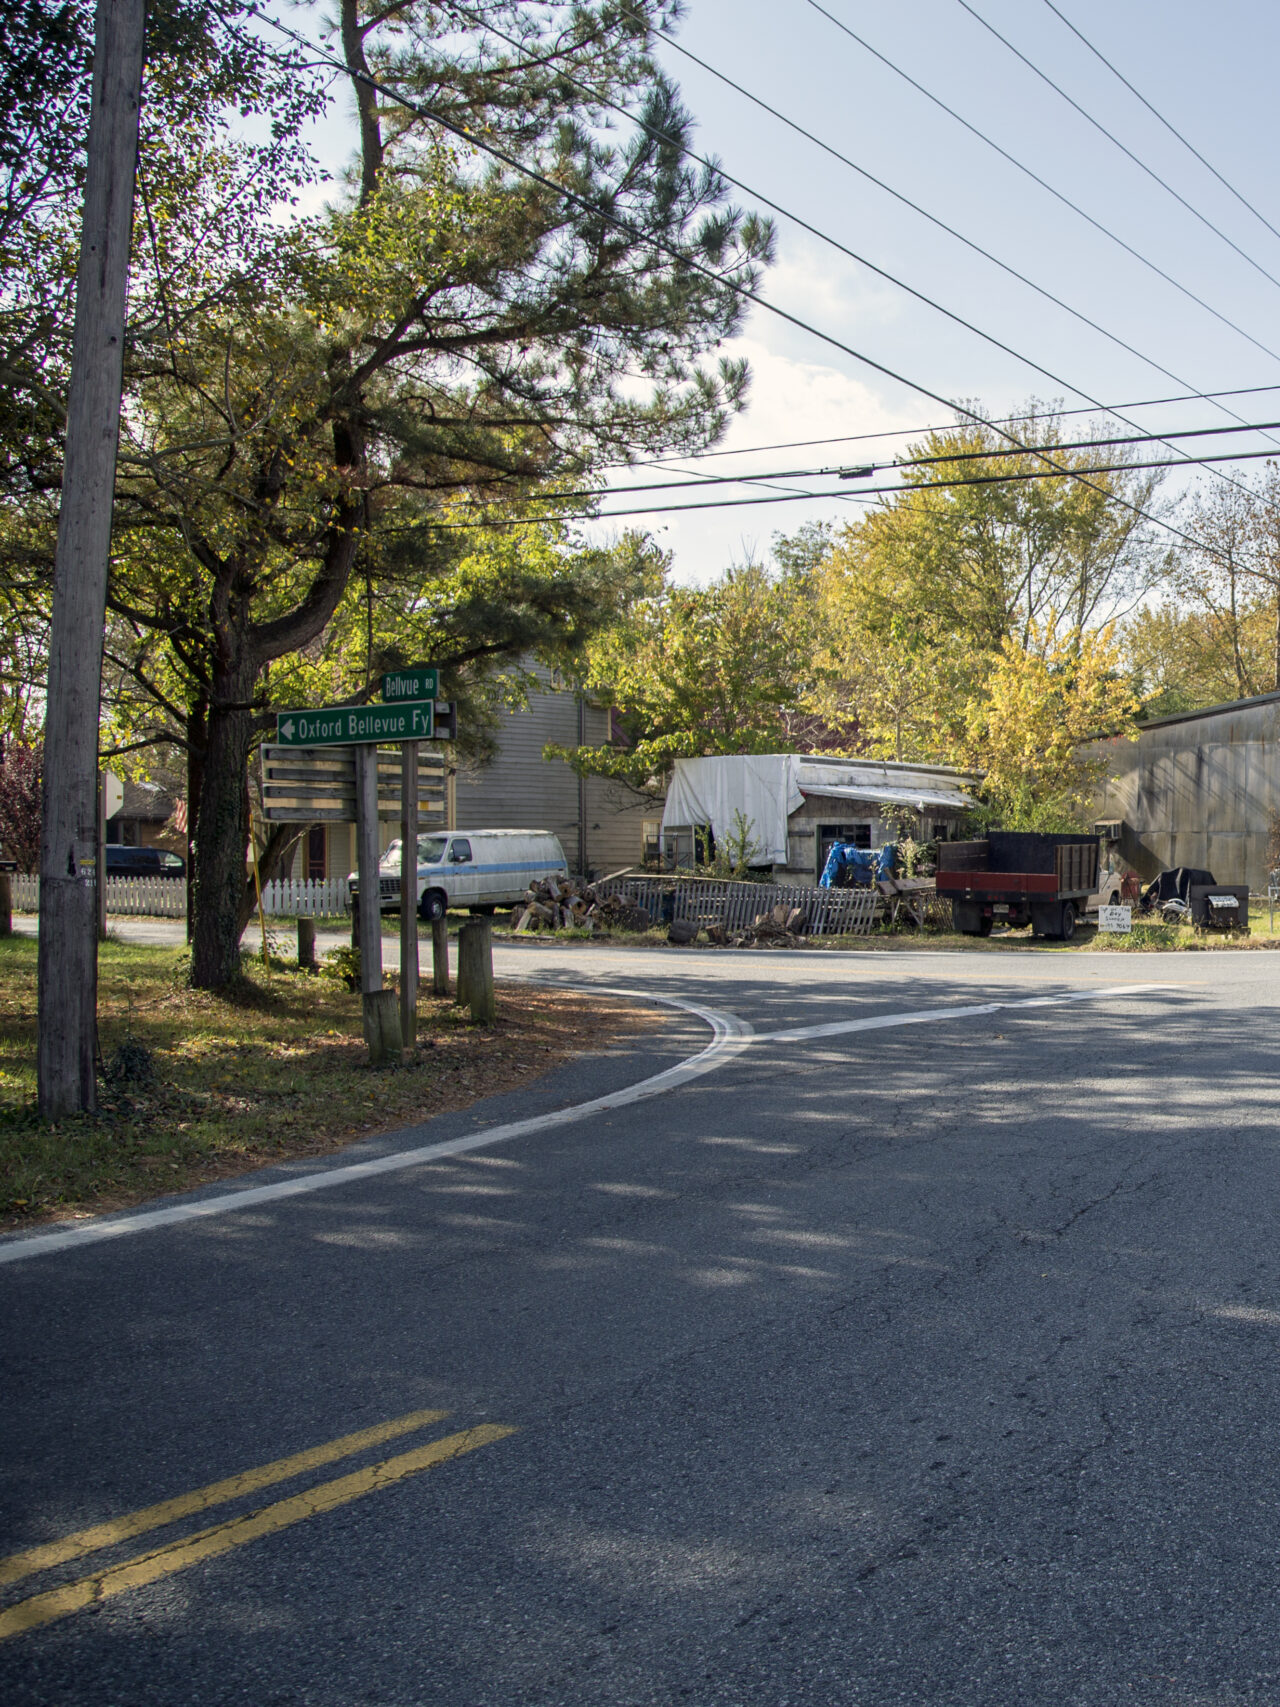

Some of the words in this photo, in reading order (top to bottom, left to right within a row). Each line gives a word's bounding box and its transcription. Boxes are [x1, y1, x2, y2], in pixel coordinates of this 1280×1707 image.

[385, 676, 419, 697] Bellvue
[425, 678, 434, 689] RD
[298, 718, 342, 739] Oxford
[348, 714, 405, 736] Bellevue
[412, 709, 429, 734] Fy
